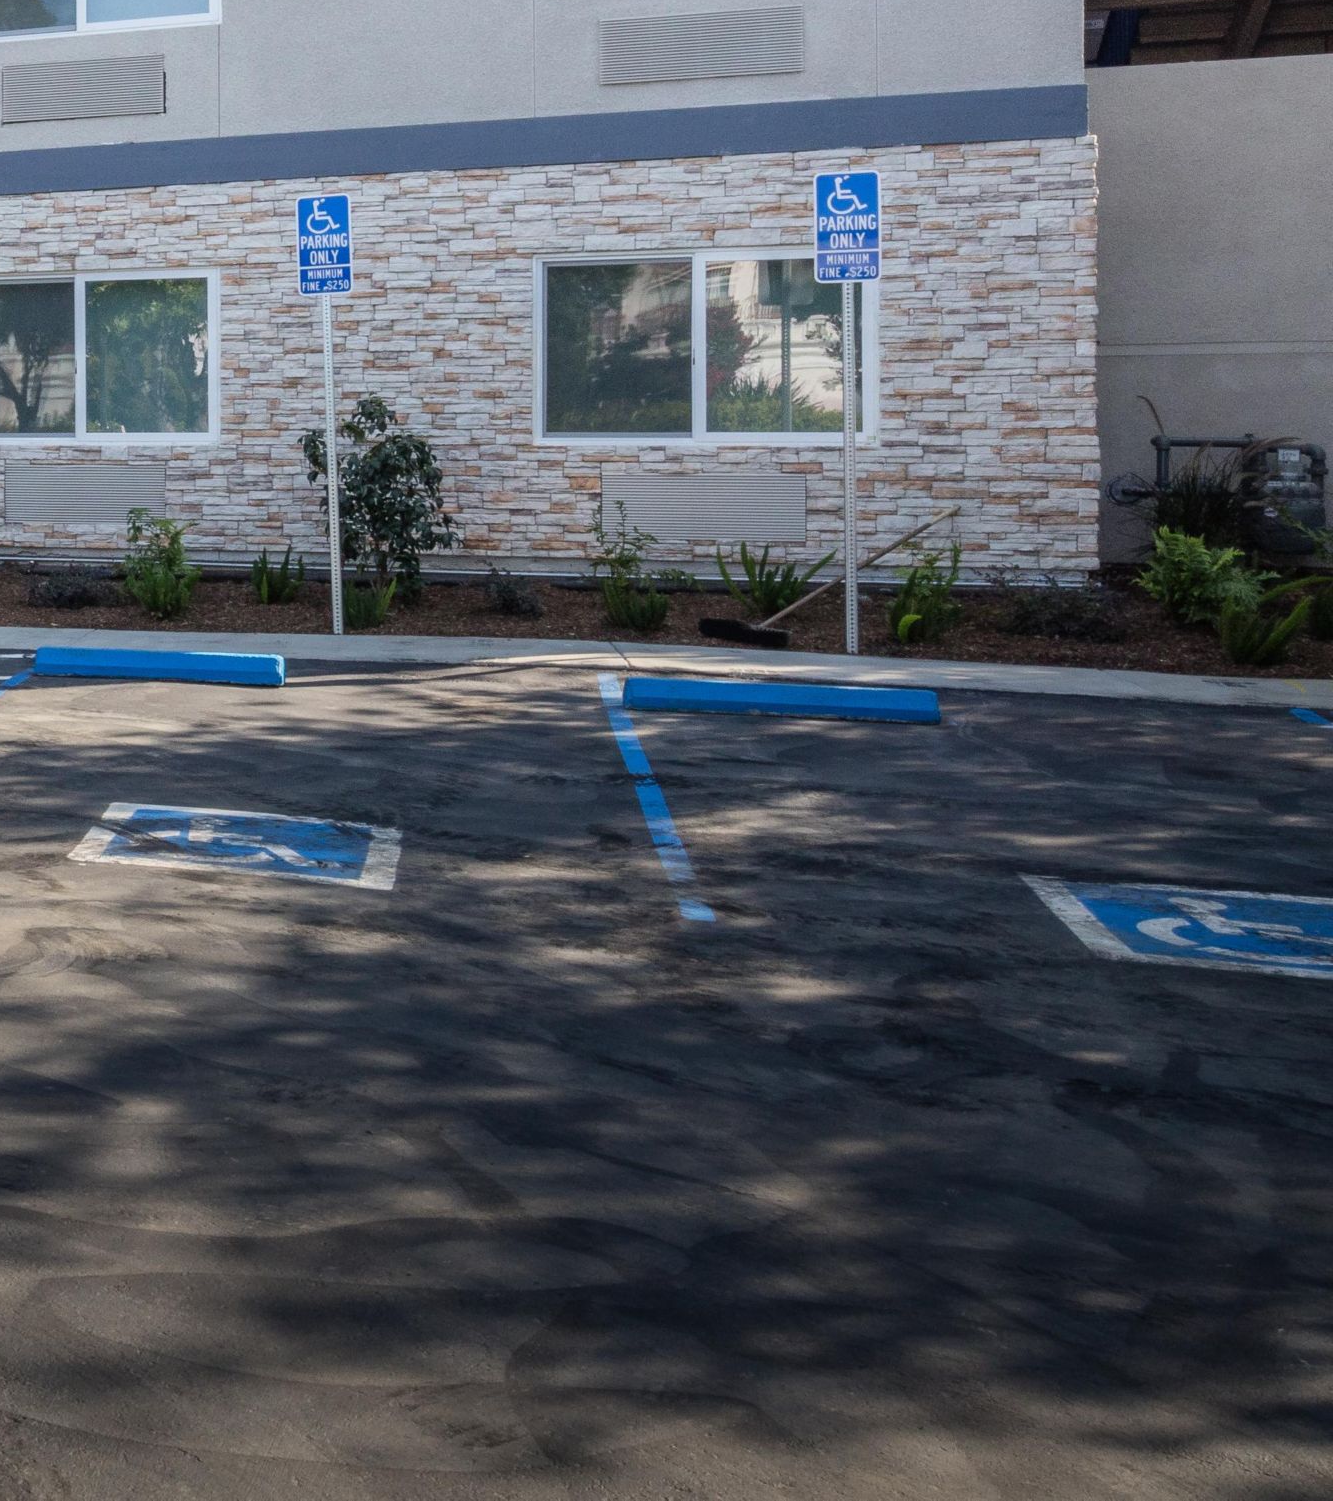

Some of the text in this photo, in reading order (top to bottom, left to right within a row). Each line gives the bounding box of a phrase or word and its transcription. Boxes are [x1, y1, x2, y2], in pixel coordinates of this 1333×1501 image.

[819, 214, 877, 232] PARKING
[300, 233, 348, 250] PARKING
[829, 232, 866, 249] ONLY
[309, 250, 339, 265] ONLY
[826, 253, 870, 266] MINIMUM
[307, 268, 343, 280] MINIMUM
[819, 267, 842, 278] FINE
[302, 281, 320, 292] FINE
